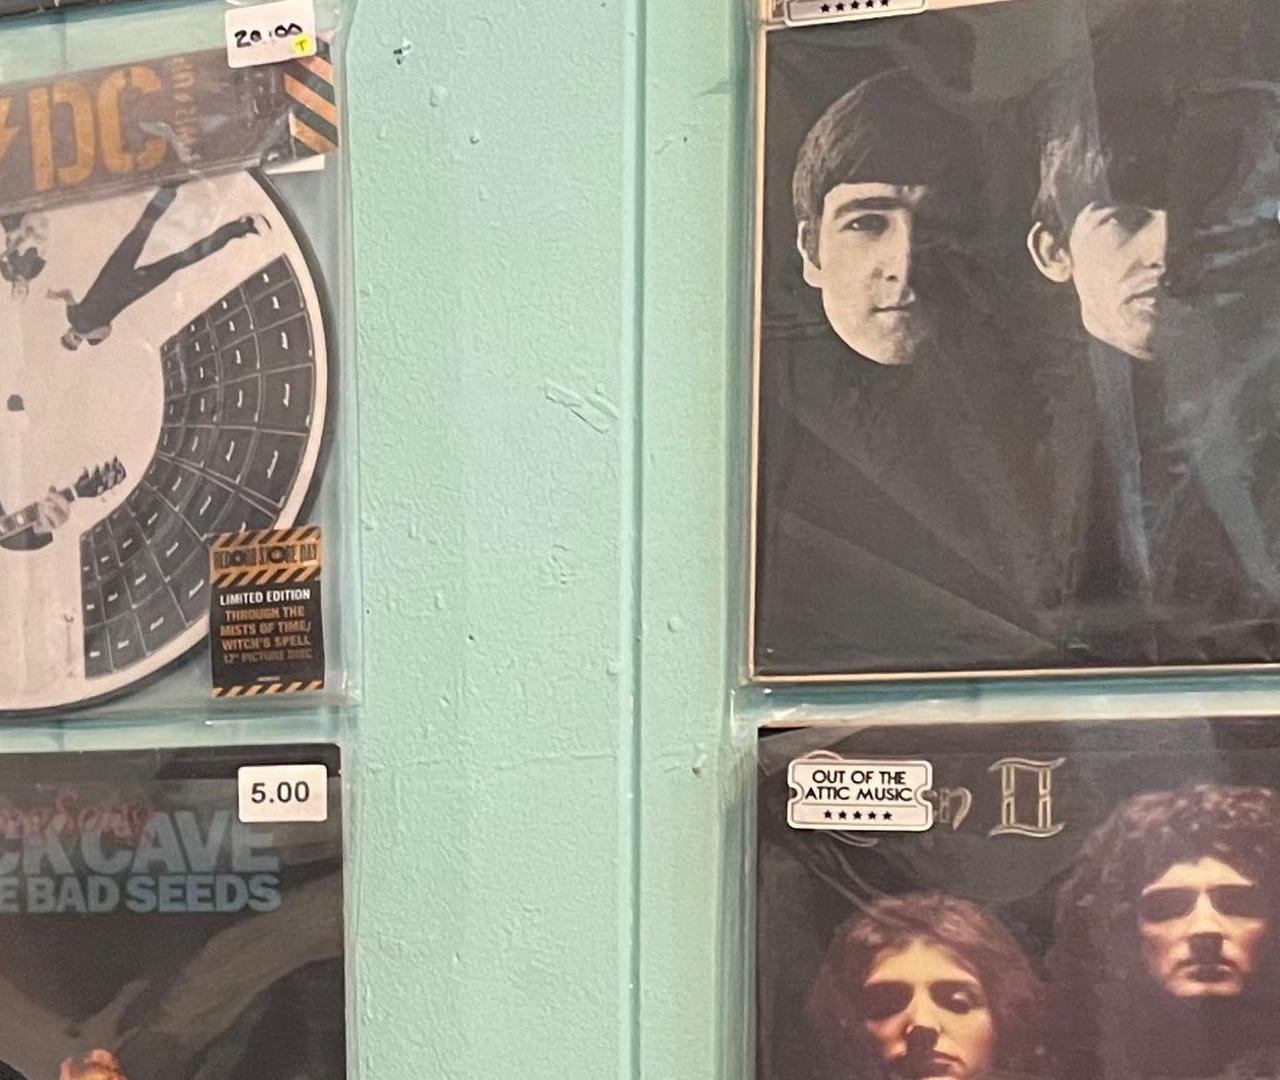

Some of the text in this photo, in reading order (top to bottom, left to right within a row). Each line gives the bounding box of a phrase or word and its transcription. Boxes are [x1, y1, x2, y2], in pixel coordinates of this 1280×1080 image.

[220, 589, 310, 606] LIMITED EDITION
[225, 606, 304, 621] THROUGH THE
[220, 624, 256, 636] MISTS
[260, 622, 274, 634] OF
[274, 635, 311, 648] SPELL
[812, 769, 906, 785] OUT OF THE
[251, 781, 310, 804] 5.00
[805, 787, 913, 801] ATTIC MUSIC
[79, 810, 282, 875] CAVE
[26, 877, 120, 913] BAD
[124, 874, 283, 913] SEEDS
